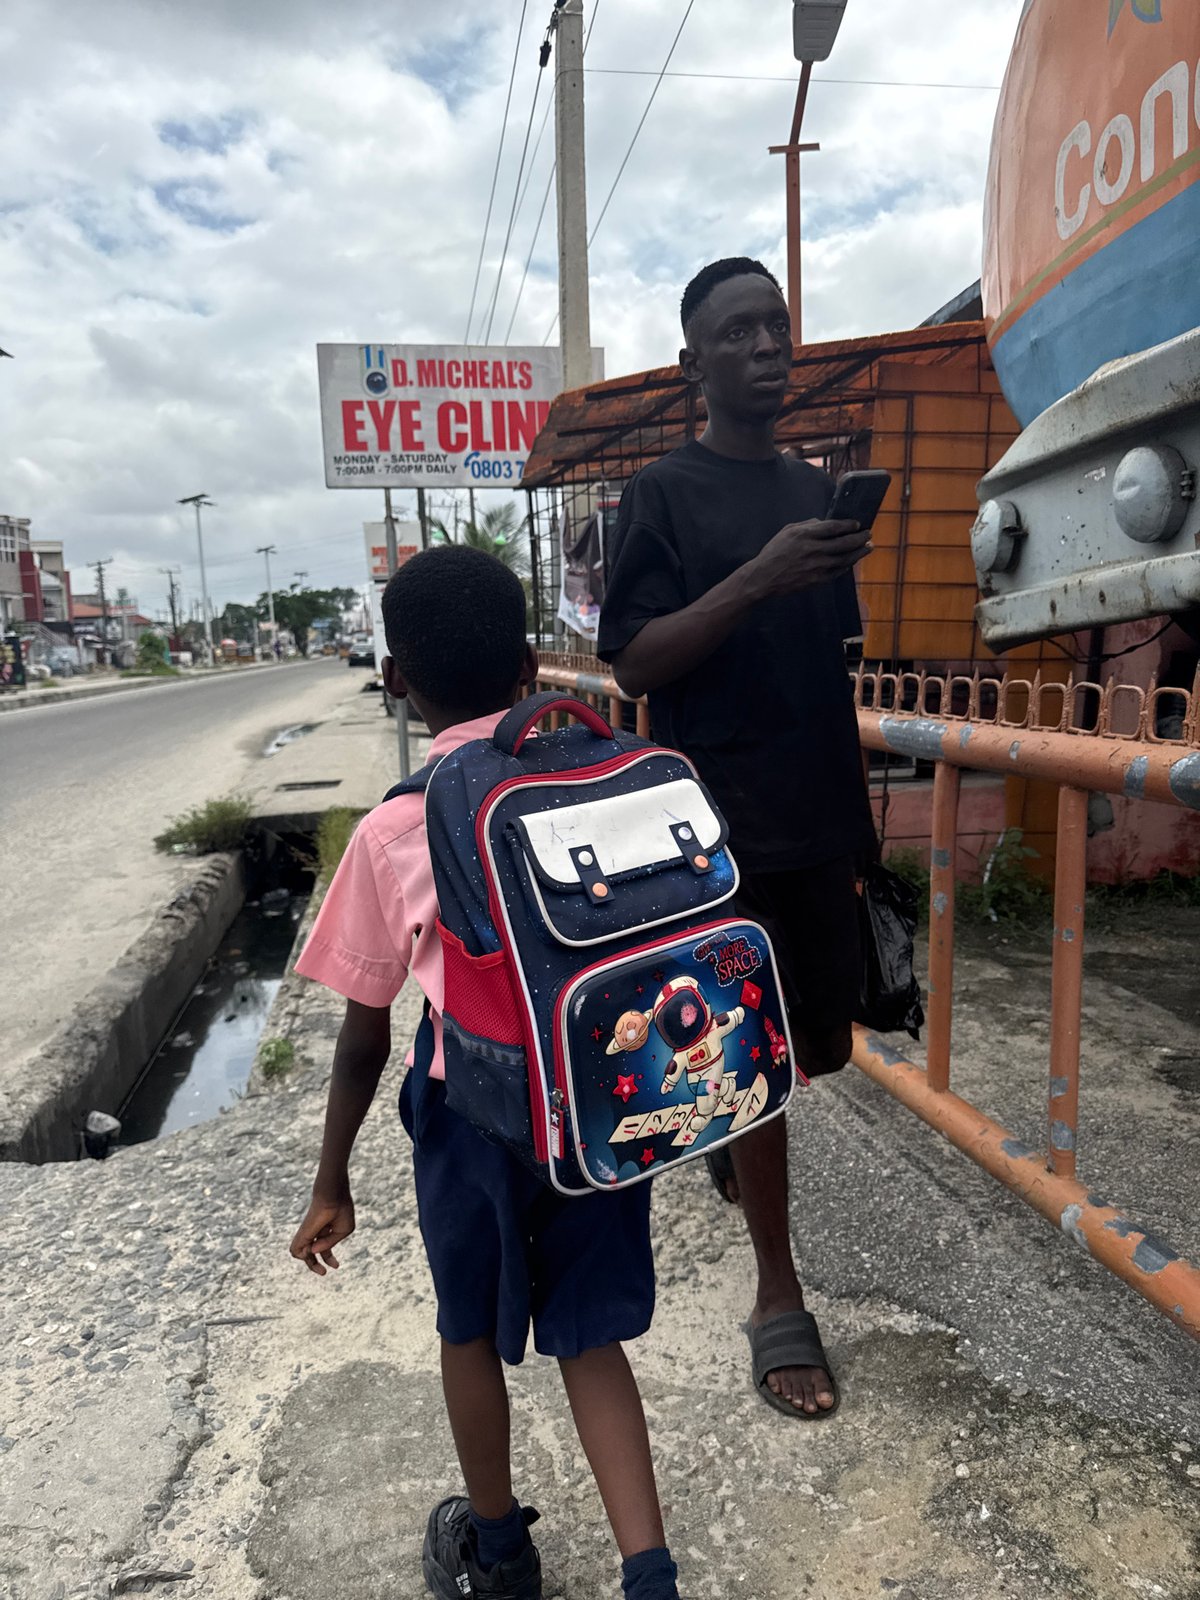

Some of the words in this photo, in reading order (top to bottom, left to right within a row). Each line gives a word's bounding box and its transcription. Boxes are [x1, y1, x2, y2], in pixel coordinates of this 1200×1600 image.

[391, 359, 413, 388] D.
[416, 358, 533, 390] MICHEAL'S
[341, 400, 425, 452] EYE
[333, 455, 381, 465] MONDAY
[391, 454, 449, 464] SATURDAY
[335, 466, 375, 476] 7:00AM
[385, 465, 423, 474] 7:00PM
[426, 464, 458, 473] DAILY
[719, 940, 746, 960] MORE
[718, 948, 758, 980] SPACE
